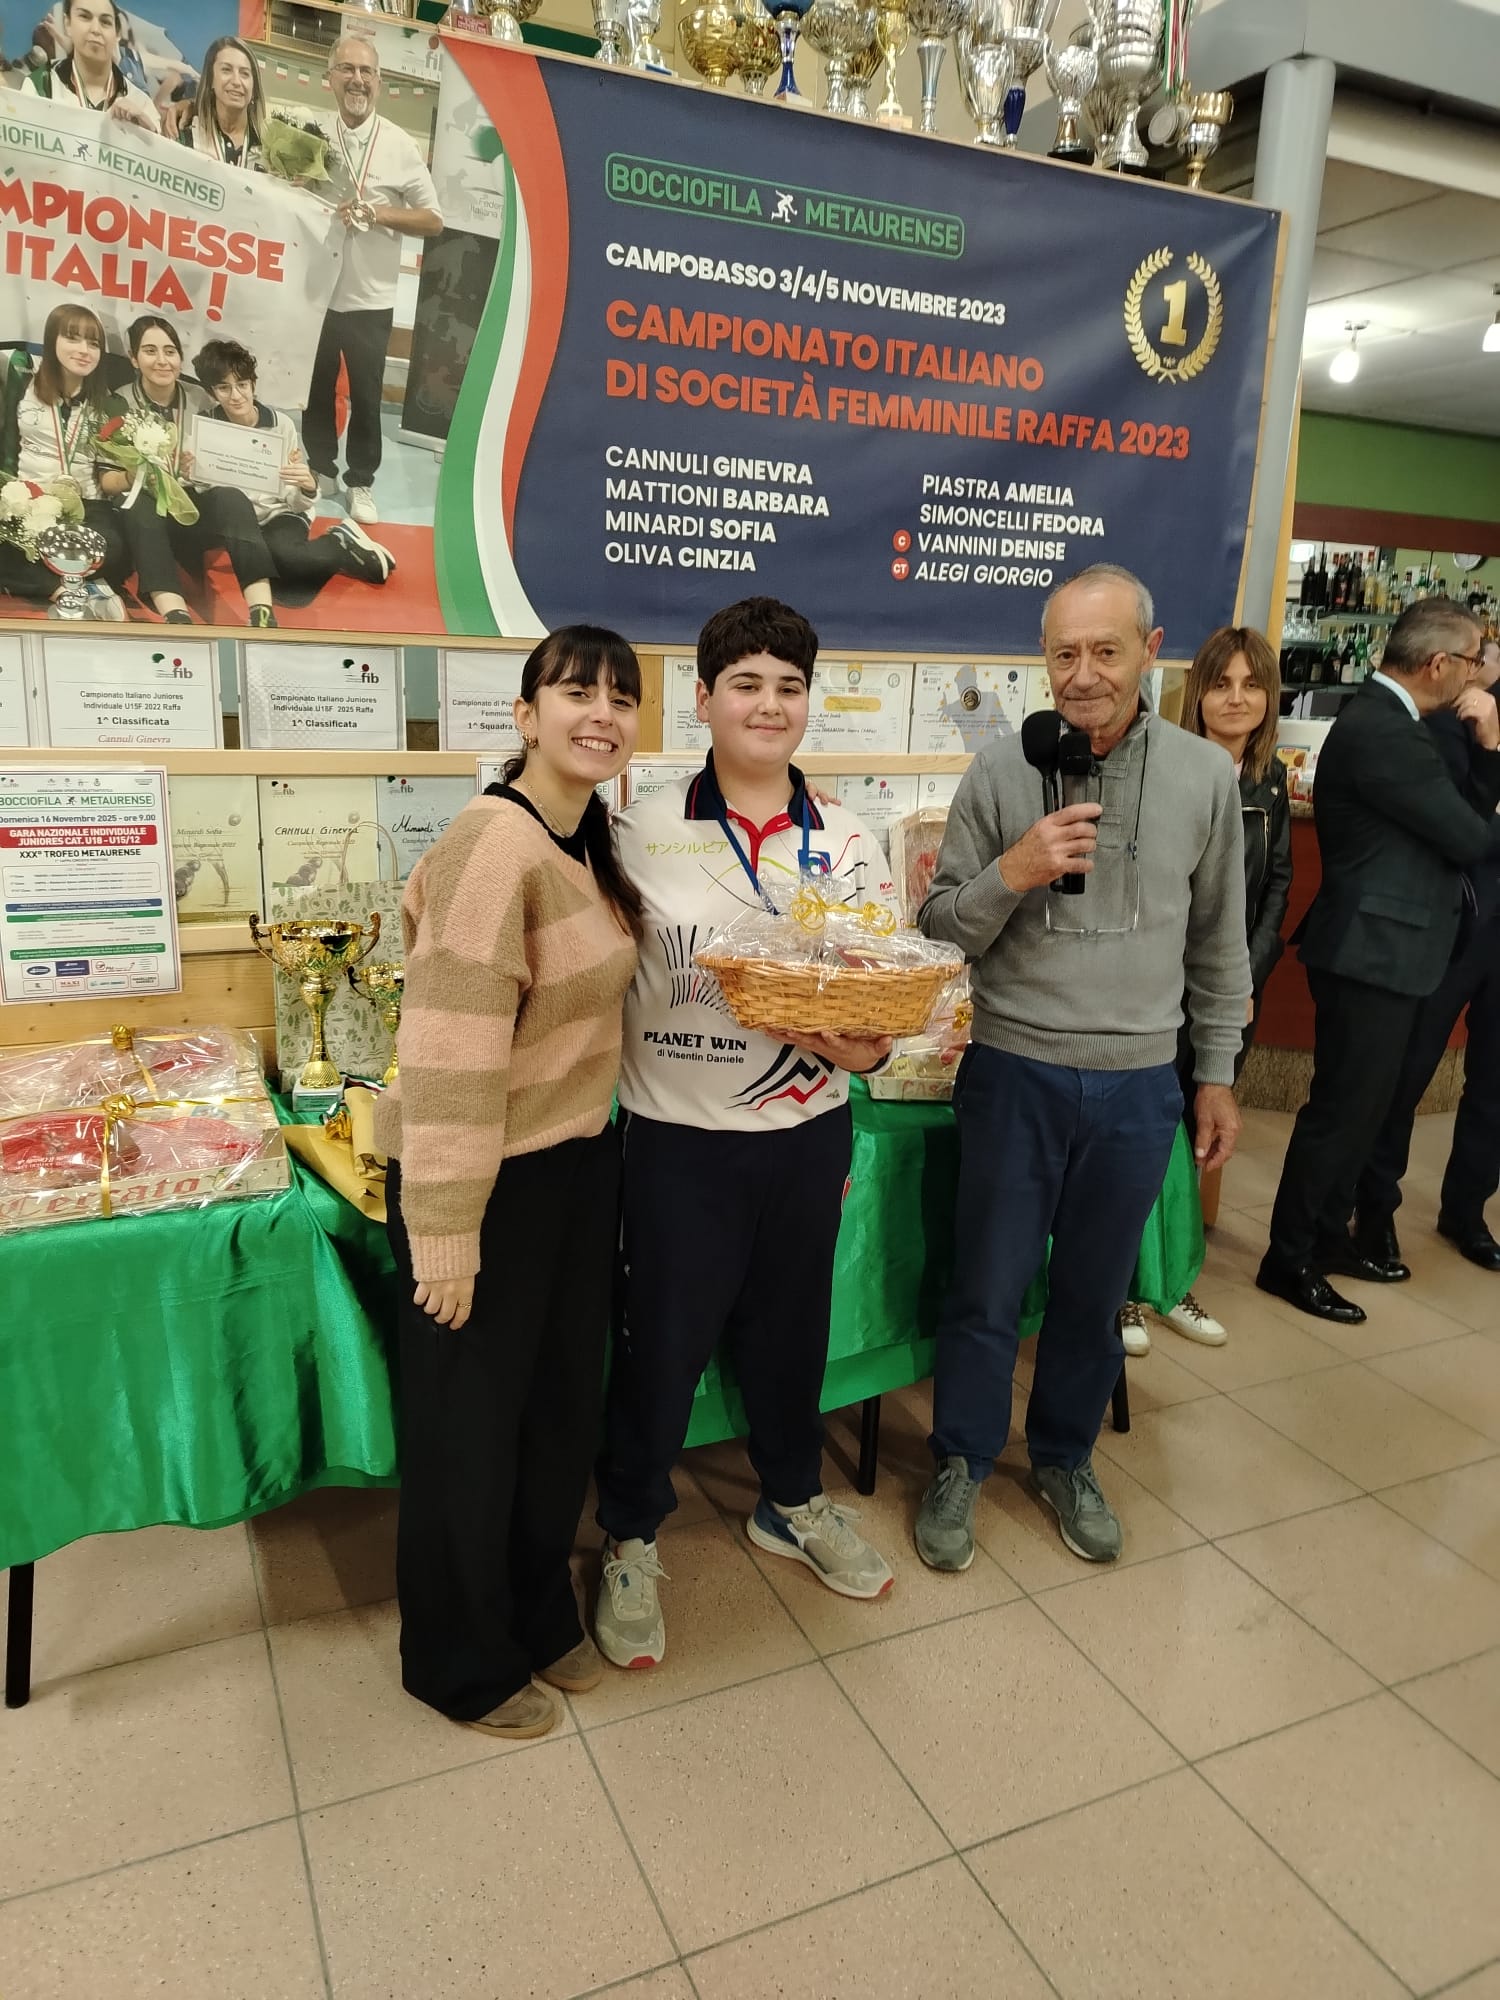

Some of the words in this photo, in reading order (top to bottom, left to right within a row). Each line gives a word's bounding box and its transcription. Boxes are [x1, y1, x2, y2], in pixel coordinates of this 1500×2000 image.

[0, 123, 65, 155] IOFILA
[98, 147, 221, 206] METAURENSE
[612, 163, 763, 216] BOCCIOFILA
[805, 198, 961, 251] METAURENSE
[0, 177, 286, 283] MPIONESSE
[6, 230, 194, 313] ITALIA
[606, 243, 776, 290] CAMPOBASSO
[779, 265, 839, 303] 3/4/5
[843, 280, 958, 318] NOVEMBRE
[959, 289, 1006, 326] 2023
[1160, 279, 1187, 347] 1
[606, 300, 880, 371] CAMPIONATO
[884, 338, 1045, 392] ITALIANO
[606, 359, 648, 401] DI
[655, 370, 822, 421] SOCIETÀ
[828, 386, 1013, 442] FEMMINILE
[1016, 408, 1115, 453] RAFFA
[1119, 420, 1191, 460] 2023
[605, 445, 708, 476] CANNULI
[713, 456, 813, 485] GINEVRA
[922, 474, 1000, 500] PIASTRA
[1004, 482, 1074, 507] AMELIA
[605, 478, 718, 508] MATTIONI
[722, 487, 830, 517] BARBARA
[605, 509, 704, 537] MINARDI
[709, 518, 777, 543] SOFIA
[920, 504, 1029, 531] SIMONCELLI
[1032, 512, 1105, 537] FEDORA
[898, 535, 906, 547] C
[917, 532, 997, 557] VANNINI
[1000, 539, 1066, 561] DENISE
[604, 541, 674, 567] OLIVA
[678, 546, 757, 572] CINZIA
[893, 563, 908, 575] CT
[914, 561, 970, 583] ALEGI
[973, 564, 1053, 588] GIORGIO
[172, 667, 193, 679] fib
[361, 672, 379, 684] fib
[80, 690, 124, 700] Campionato
[125, 691, 152, 700] Italiano
[153, 692, 184, 701] Juniores
[270, 693, 315, 704] Campionato
[317, 695, 345, 703] Italiano
[345, 696, 377, 704] Juniores
[83, 702, 123, 710] Individuale
[162, 703, 181, 711] Raffa
[273, 704, 313, 713] Individuale
[355, 706, 374, 714] Raffa
[452, 699, 492, 707] Campionato
[112, 716, 170, 726] Classificata
[305, 719, 358, 729] Classificata
[479, 722, 513, 731] Squadra
[98, 734, 134, 744] Cannuli
[136, 735, 171, 745] Ginevra
[637, 785, 665, 793] BOCCI
[879, 788, 894, 800] fib
[0, 796, 62, 806] BOCCIOFILA
[80, 795, 152, 805] METAURENSE
[0, 815, 39, 824] Domenica
[42, 815, 51, 823] 16
[52, 815, 96, 823] Novembre
[97, 814, 118, 822] 2025
[138, 814, 156, 822] 9.00
[9, 829, 36, 838] GARA
[37, 828, 89, 837] NAZIONALE
[90, 827, 147, 836] INDIVIDUALE
[274, 826, 314, 836] CANNULI
[18, 837, 64, 846] JUNIORES
[64, 837, 84, 846] CAT.
[85, 837, 102, 845] U18
[109, 836, 141, 845] U15/12
[45, 850, 80, 858] TROFEO
[81, 848, 141, 858] METAURENSE
[643, 1031, 705, 1049] PLANET
[710, 1036, 747, 1051] WIN
[657, 1048, 665, 1057] di
[667, 1050, 704, 1062] Visentin
[706, 1053, 745, 1064] Daniele
